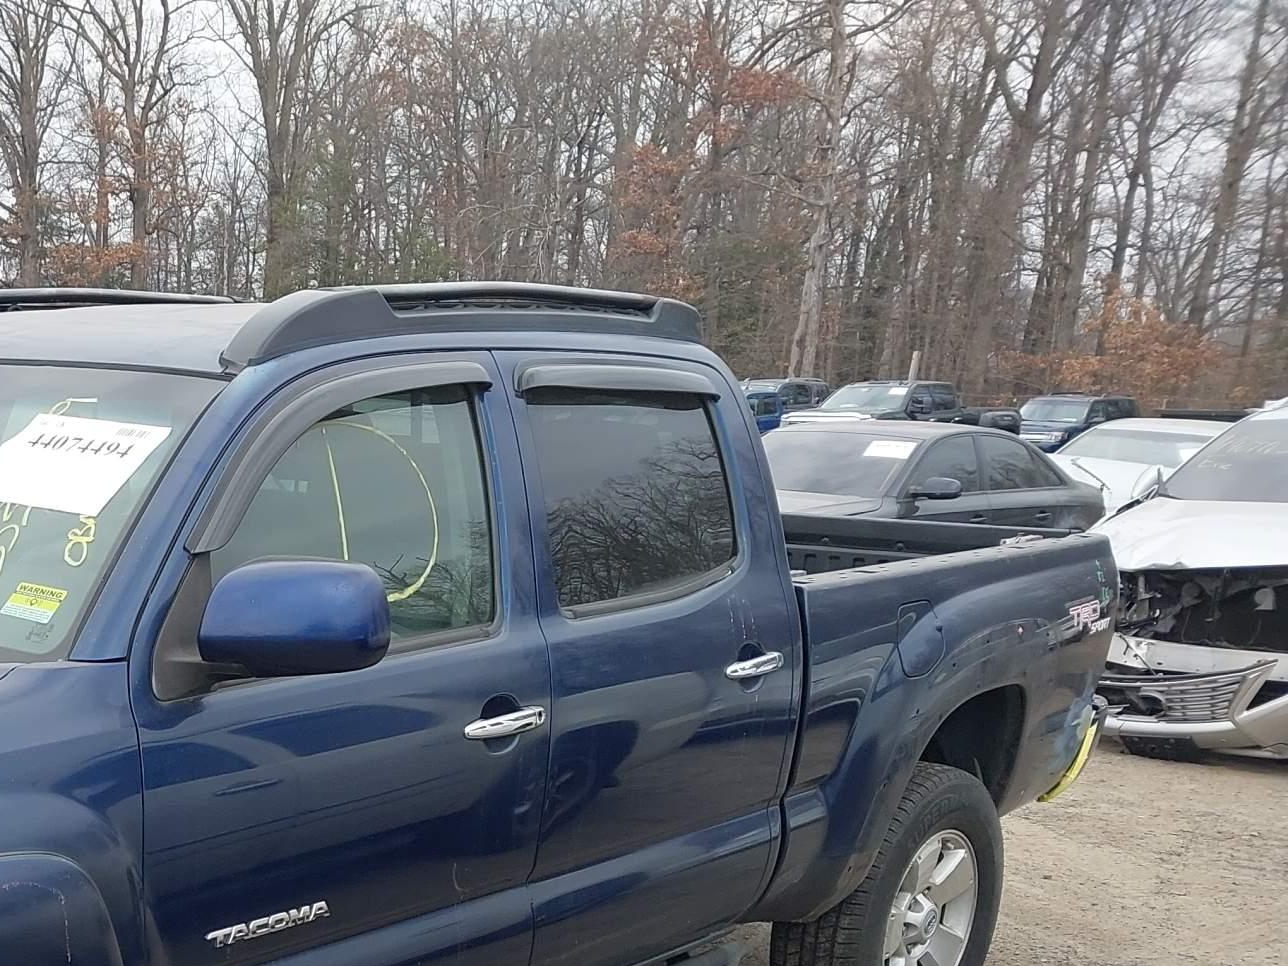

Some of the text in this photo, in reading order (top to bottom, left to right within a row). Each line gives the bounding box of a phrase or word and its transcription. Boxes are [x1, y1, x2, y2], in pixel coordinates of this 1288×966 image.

[28, 433, 135, 458] 44074494
[19, 584, 64, 599] WARNING
[1069, 599, 1100, 631] TRD
[1089, 616, 1111, 634] SPORT
[205, 900, 331, 948] TACOMA
